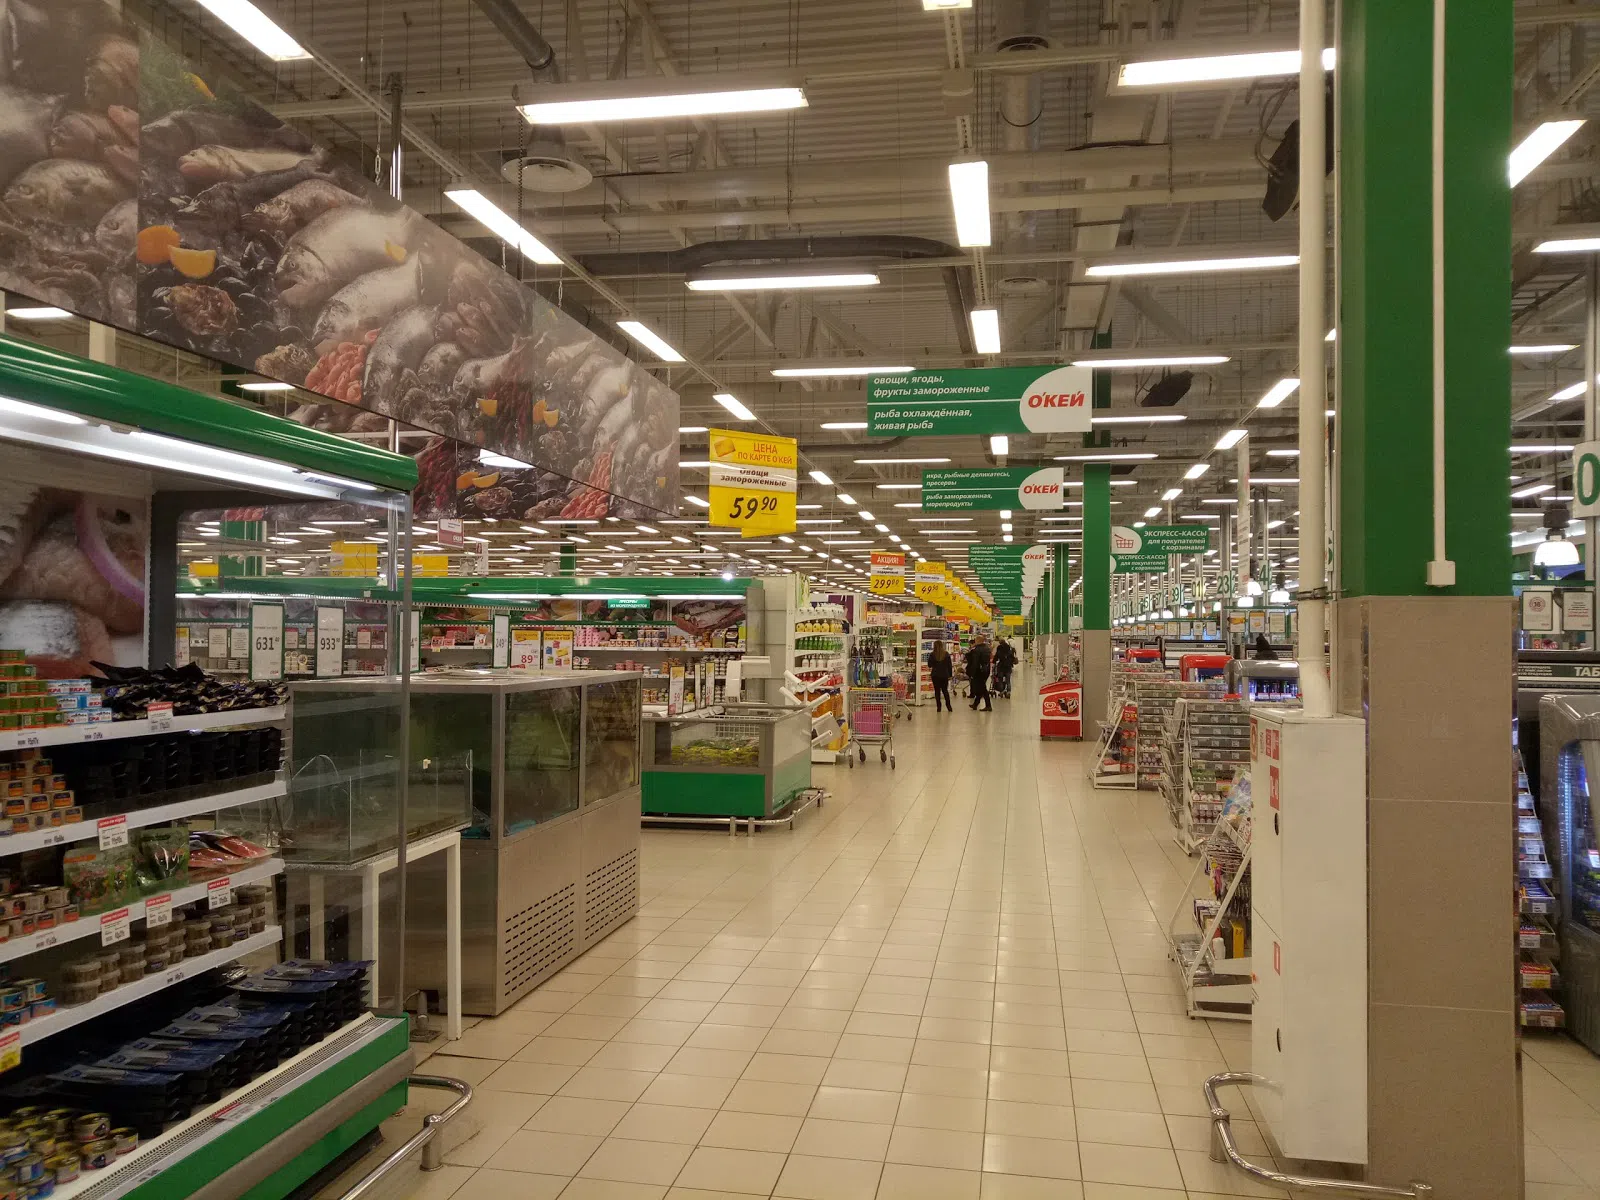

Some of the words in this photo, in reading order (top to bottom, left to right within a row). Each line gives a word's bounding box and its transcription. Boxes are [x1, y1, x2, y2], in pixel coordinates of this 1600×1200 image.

[873, 376, 909, 385] овощи,
[911, 374, 945, 385] ягоды,
[873, 388, 911, 398] фрукты
[912, 385, 990, 396] замороженные
[874, 410, 900, 420] рыба
[902, 408, 973, 419] охлаждённая,
[874, 422, 906, 431] живая
[906, 421, 933, 431] рыба
[753, 442, 778, 454] ЦЕНА
[737, 451, 748, 460] ПО
[749, 453, 771, 462] КАРТЕ
[720, 474, 787, 487] замороженные
[943, 472, 969, 480] рыбные
[970, 471, 1011, 479] деликатесы,
[925, 493, 943, 501] рыба
[729, 496, 758, 520] 59
[761, 496, 778, 511] 90
[1161, 538, 1206, 546] покупателей
[876, 555, 899, 564] АКЦИЯ!
[873, 579, 892, 589] 299
[256, 637, 274, 651] 631
[320, 637, 336, 651] 933
[521, 654, 533, 664] 89
